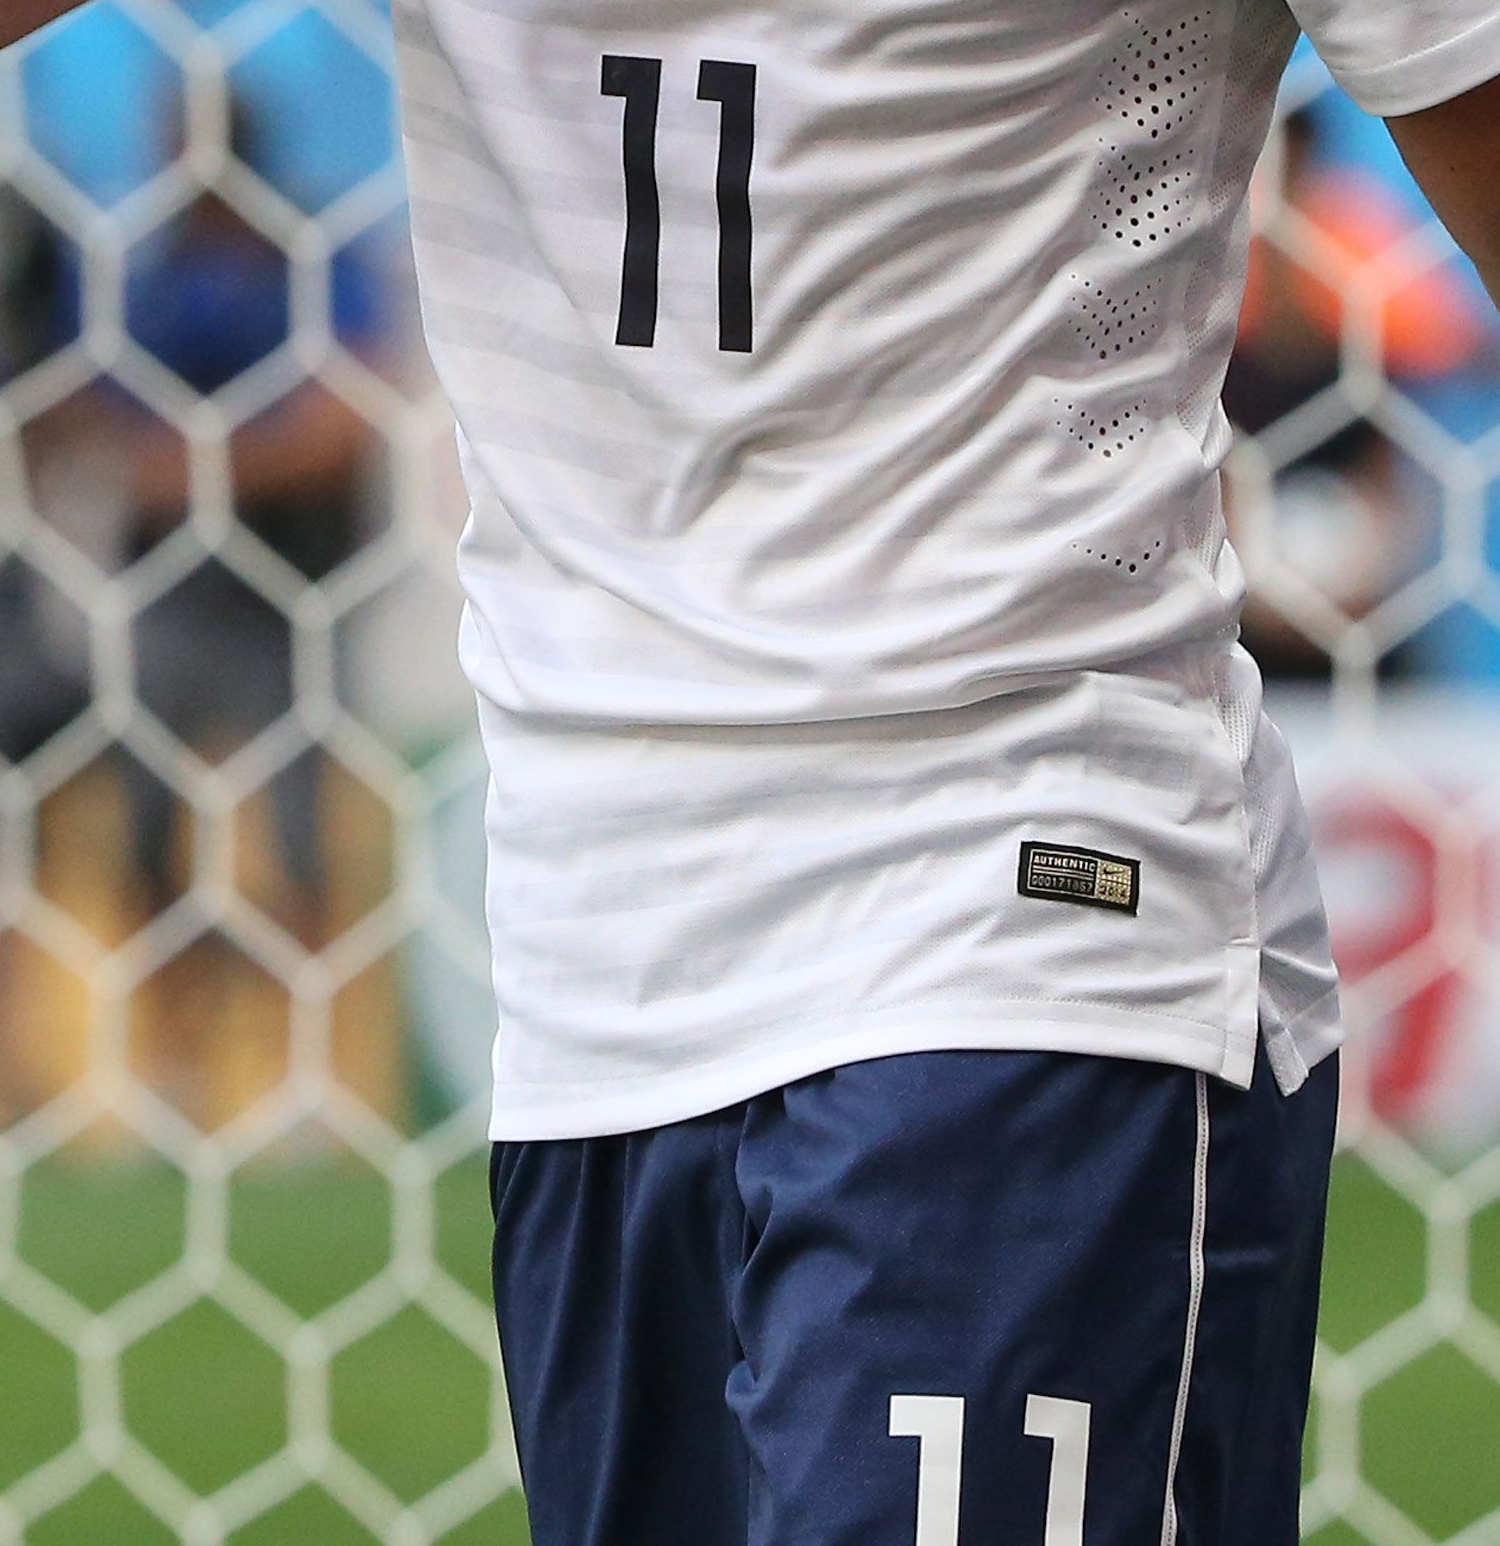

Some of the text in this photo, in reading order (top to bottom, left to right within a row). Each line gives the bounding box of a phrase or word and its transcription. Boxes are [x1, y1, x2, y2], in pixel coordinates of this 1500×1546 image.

[601, 55, 757, 353] 11
[1033, 855, 1097, 872] AUTHENTIC
[889, 1394, 1091, 1546] 11
